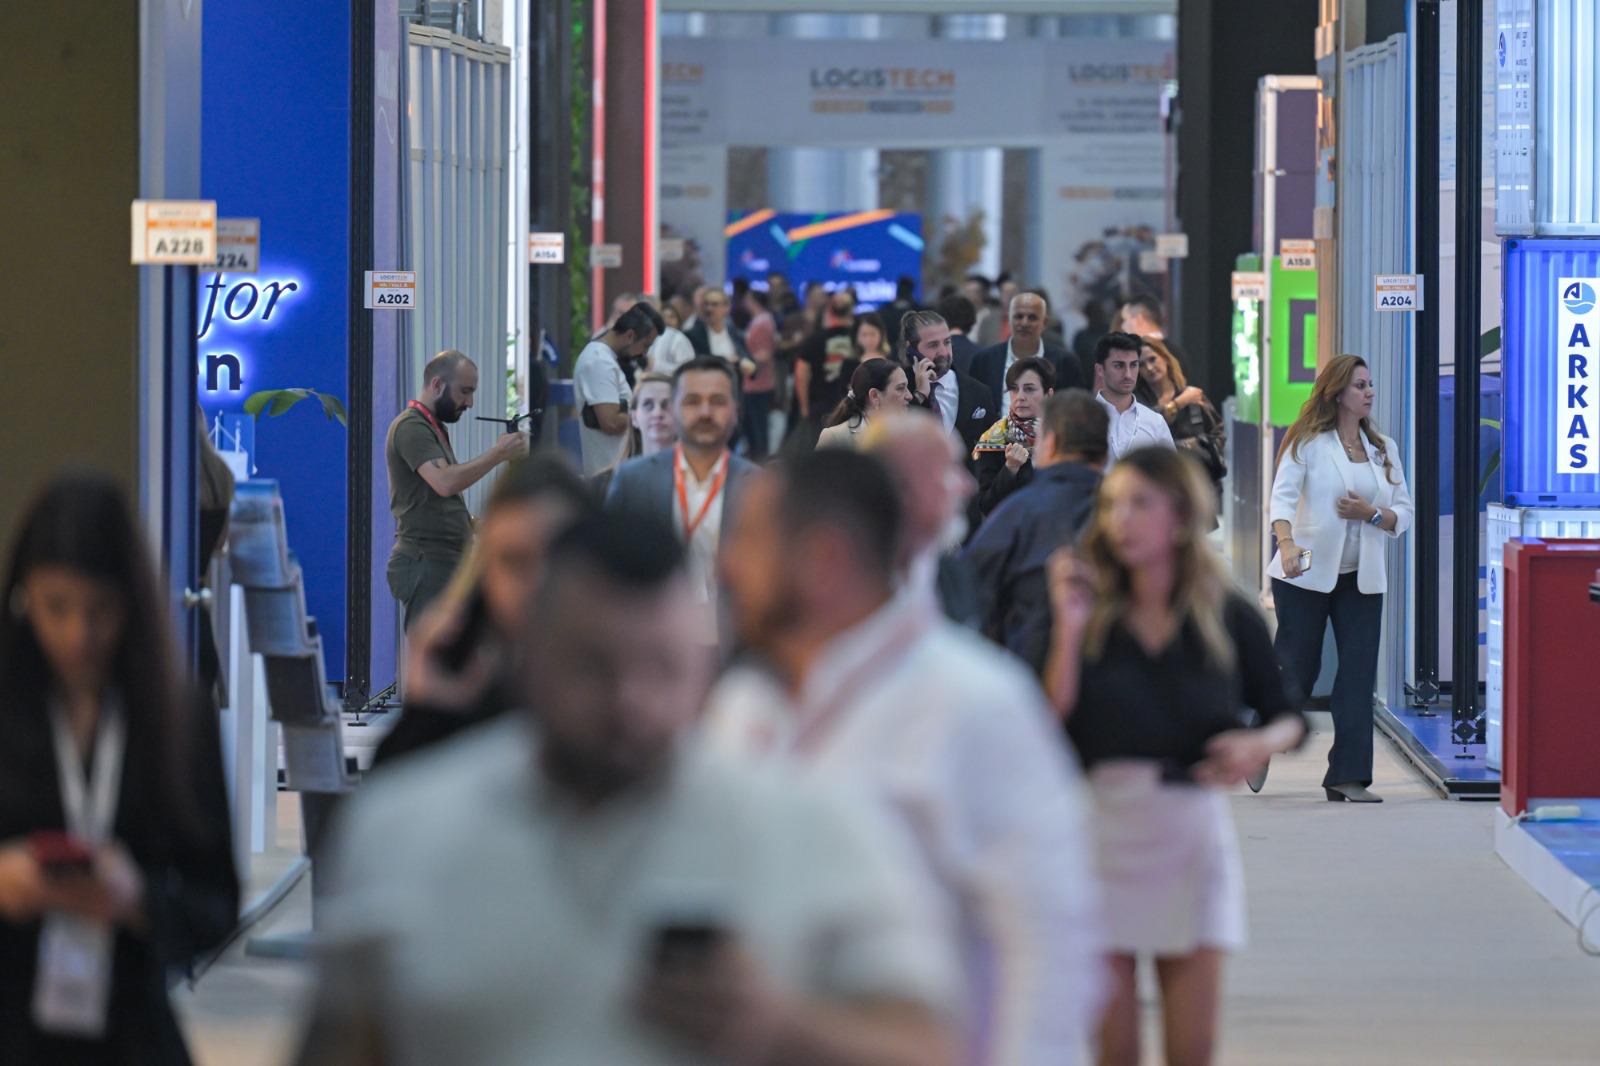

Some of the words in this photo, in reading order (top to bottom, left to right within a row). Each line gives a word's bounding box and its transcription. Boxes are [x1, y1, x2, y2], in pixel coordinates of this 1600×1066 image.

[810, 68, 955, 87] LOGISTECH
[155, 237, 204, 254] A228
[203, 253, 248, 268] 224
[197, 272, 297, 338] for
[378, 294, 409, 304] A202
[1381, 296, 1412, 306] A204
[1567, 323, 1591, 469] ARKAS
